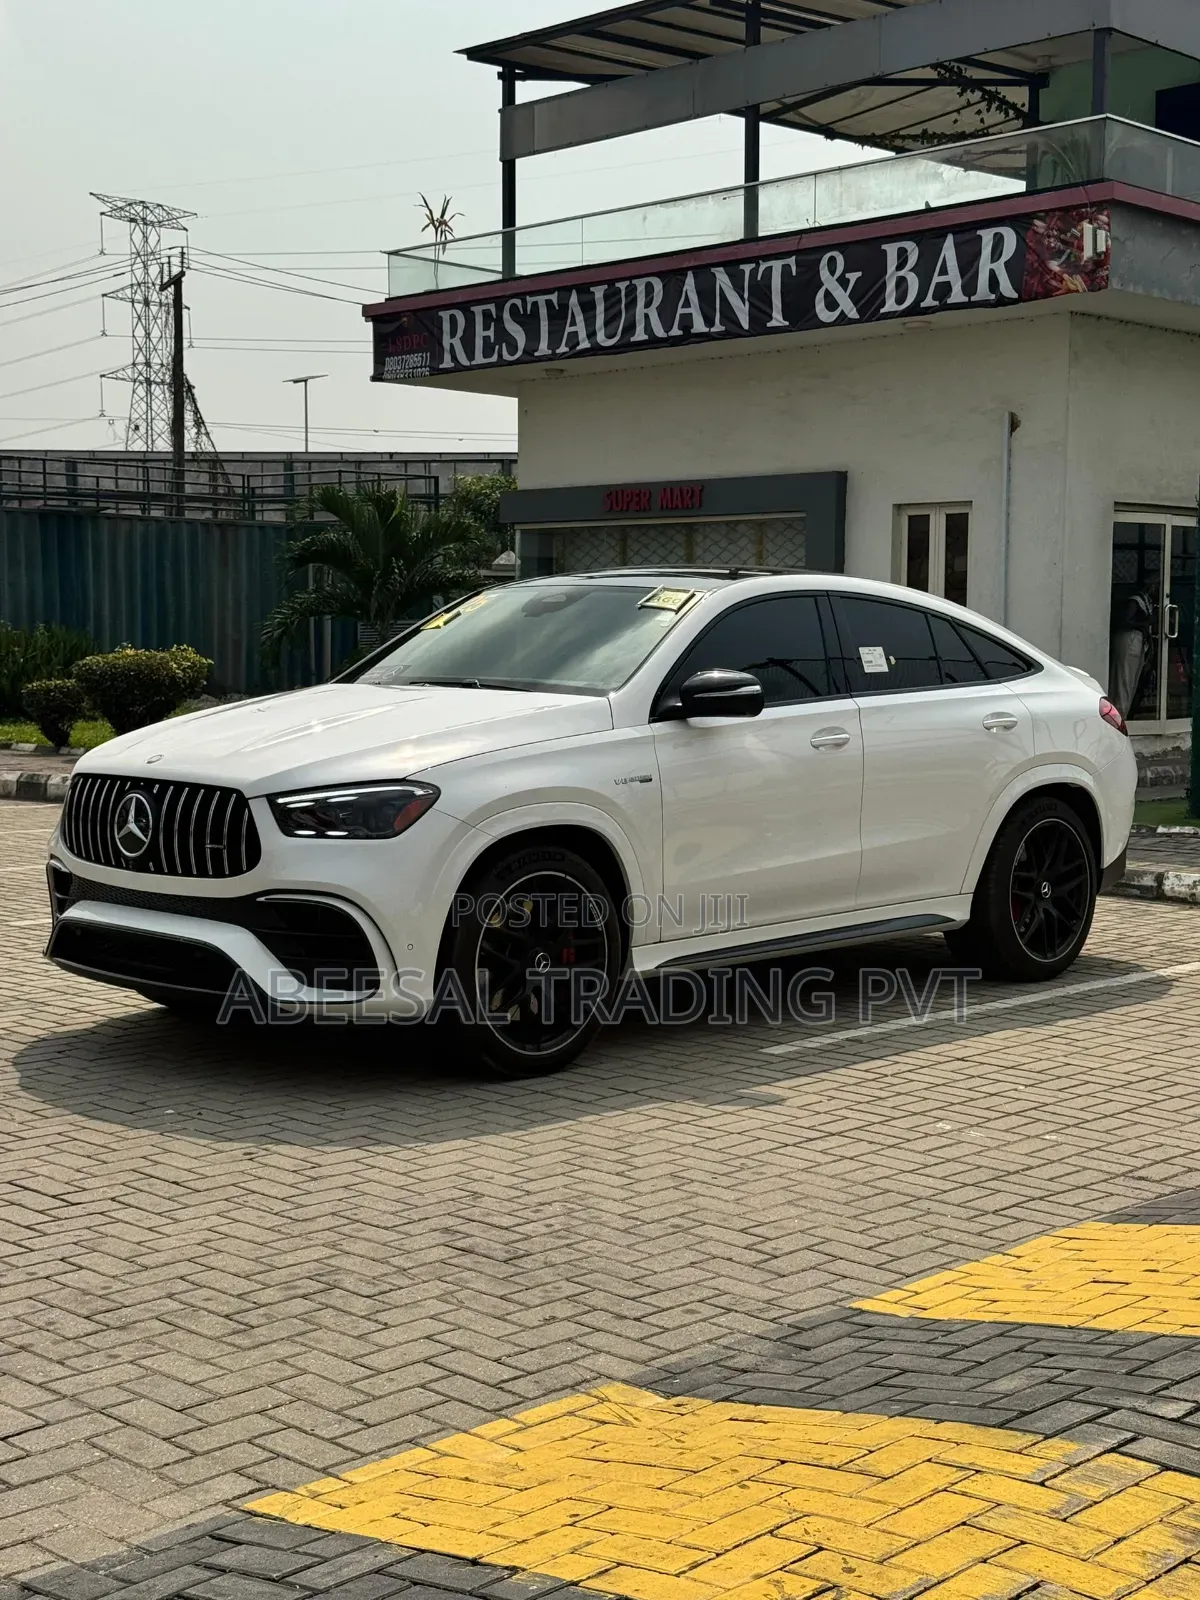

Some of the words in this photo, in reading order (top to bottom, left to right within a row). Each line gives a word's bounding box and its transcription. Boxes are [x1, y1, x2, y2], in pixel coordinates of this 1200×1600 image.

[438, 255, 797, 369] RESTAURANT
[814, 250, 862, 324] &
[879, 226, 1019, 314] BAR
[603, 489, 651, 512] SUPER
[658, 483, 704, 510] MART
